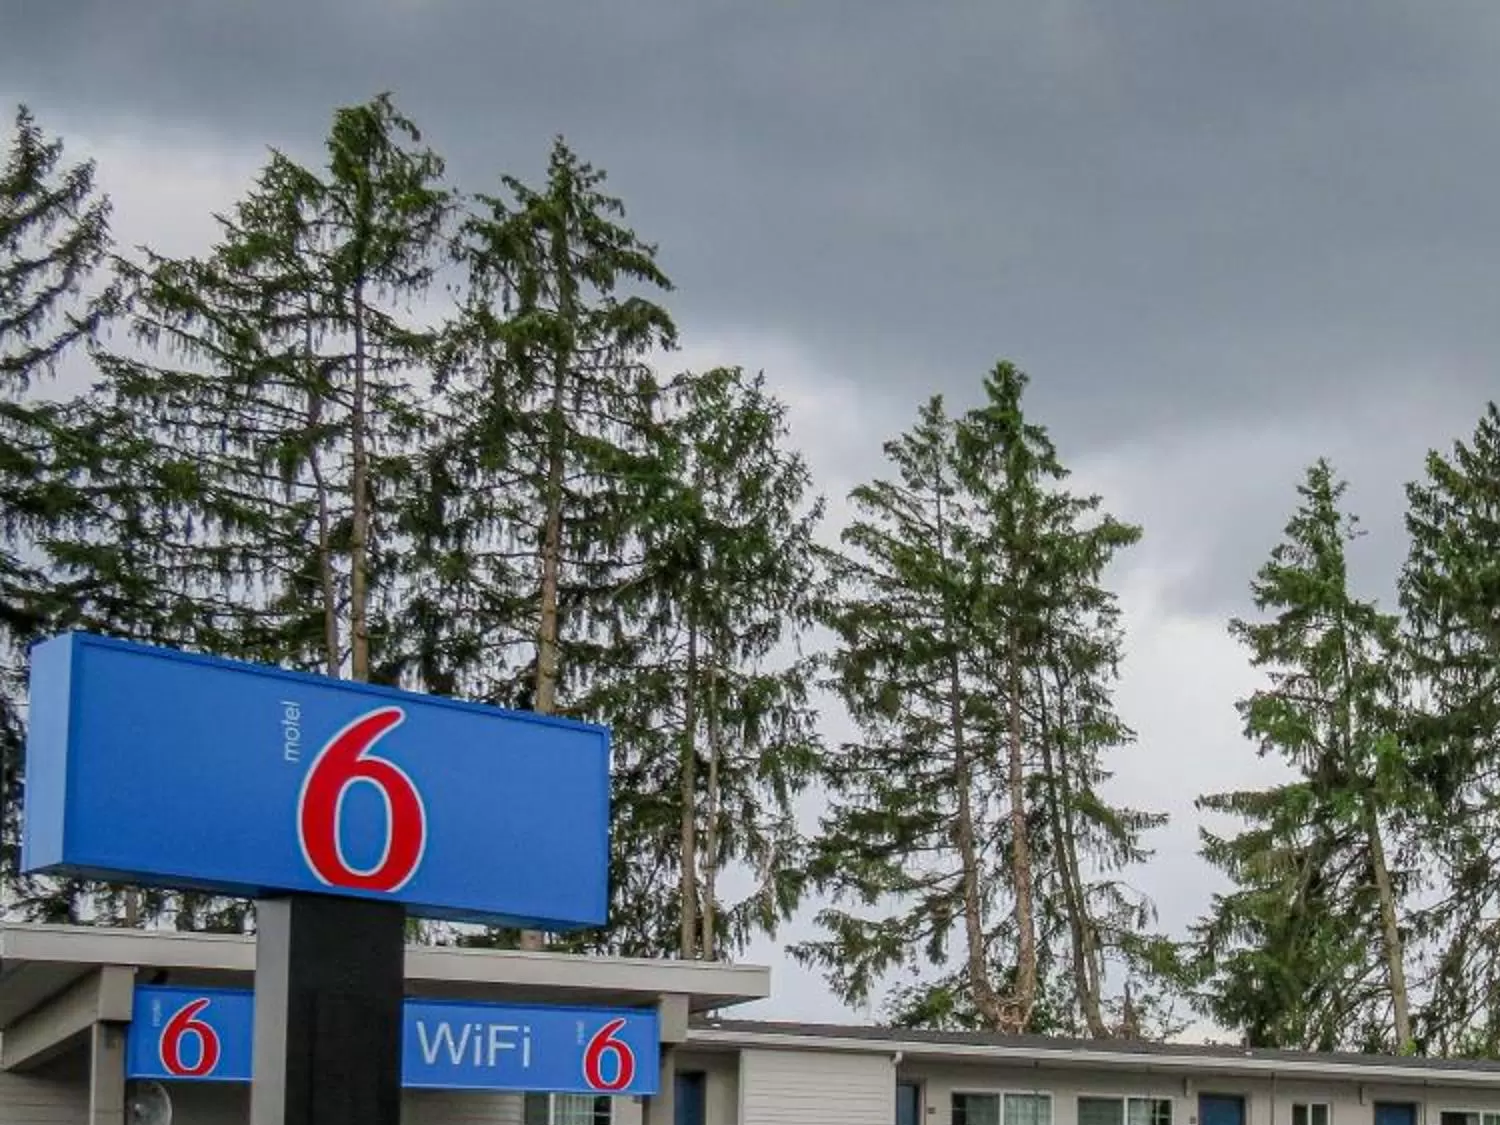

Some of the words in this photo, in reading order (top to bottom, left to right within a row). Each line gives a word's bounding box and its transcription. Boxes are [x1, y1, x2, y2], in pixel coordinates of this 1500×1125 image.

[280, 701, 300, 763] motel
[297, 706, 427, 893] 6
[159, 997, 221, 1077] 6
[416, 1020, 531, 1067] WiFi
[583, 1017, 636, 1091] 6
